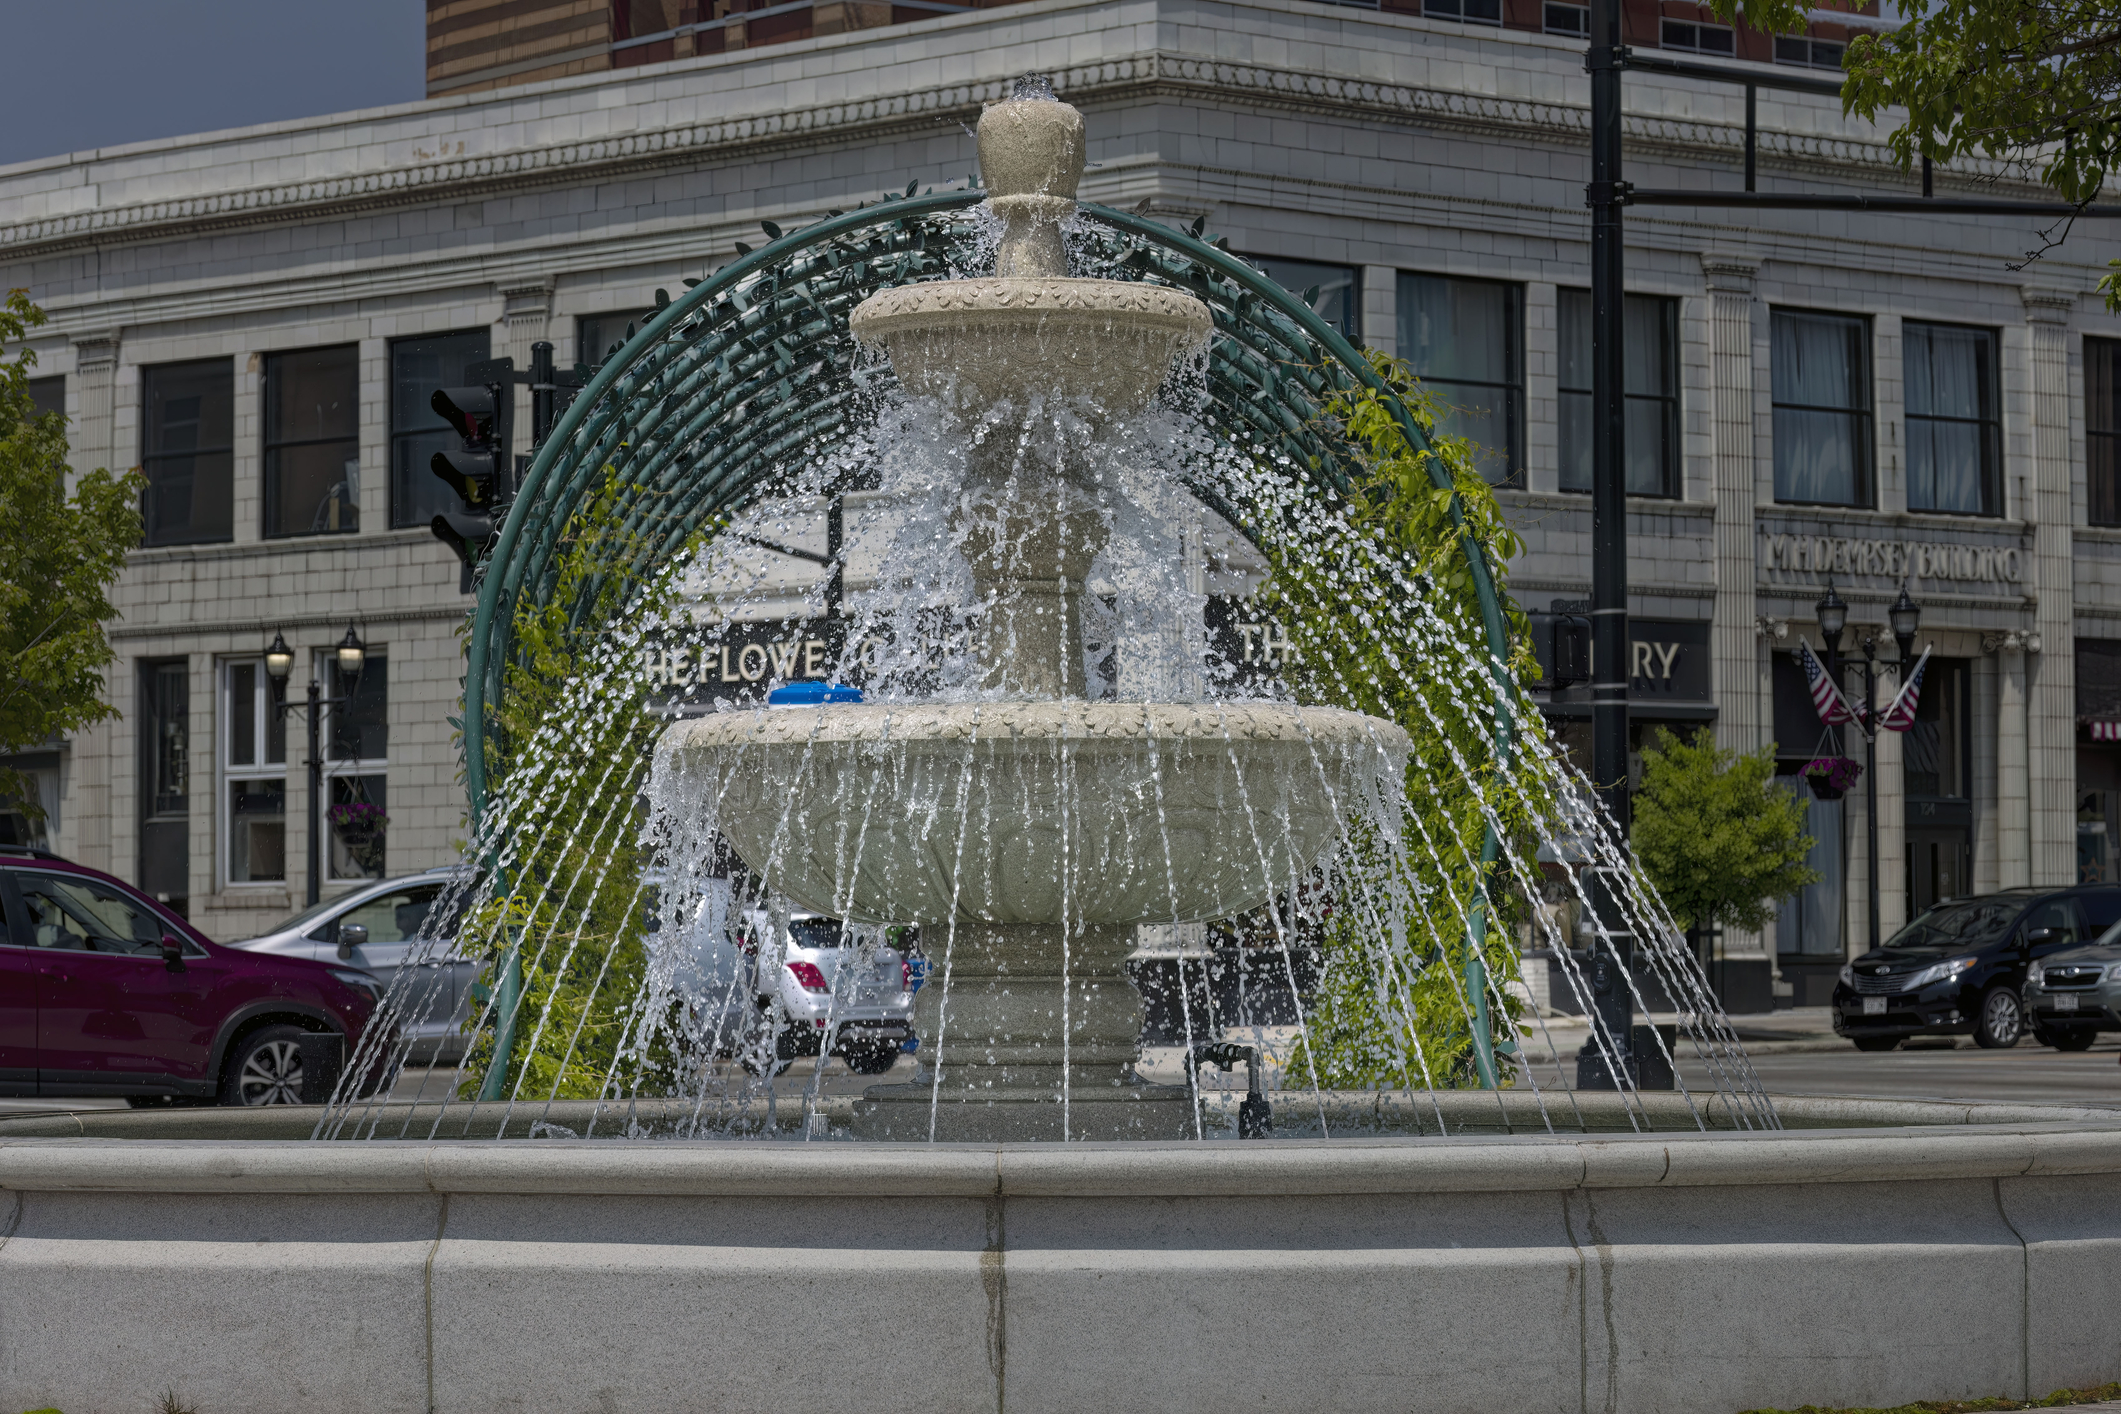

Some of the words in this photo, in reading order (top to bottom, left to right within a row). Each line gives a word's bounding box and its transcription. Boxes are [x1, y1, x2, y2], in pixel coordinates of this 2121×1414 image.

[1815, 536, 1917, 577] DEMPSEY
[1918, 542, 2021, 583] BUILDING
[699, 639, 850, 683] FLOWE
